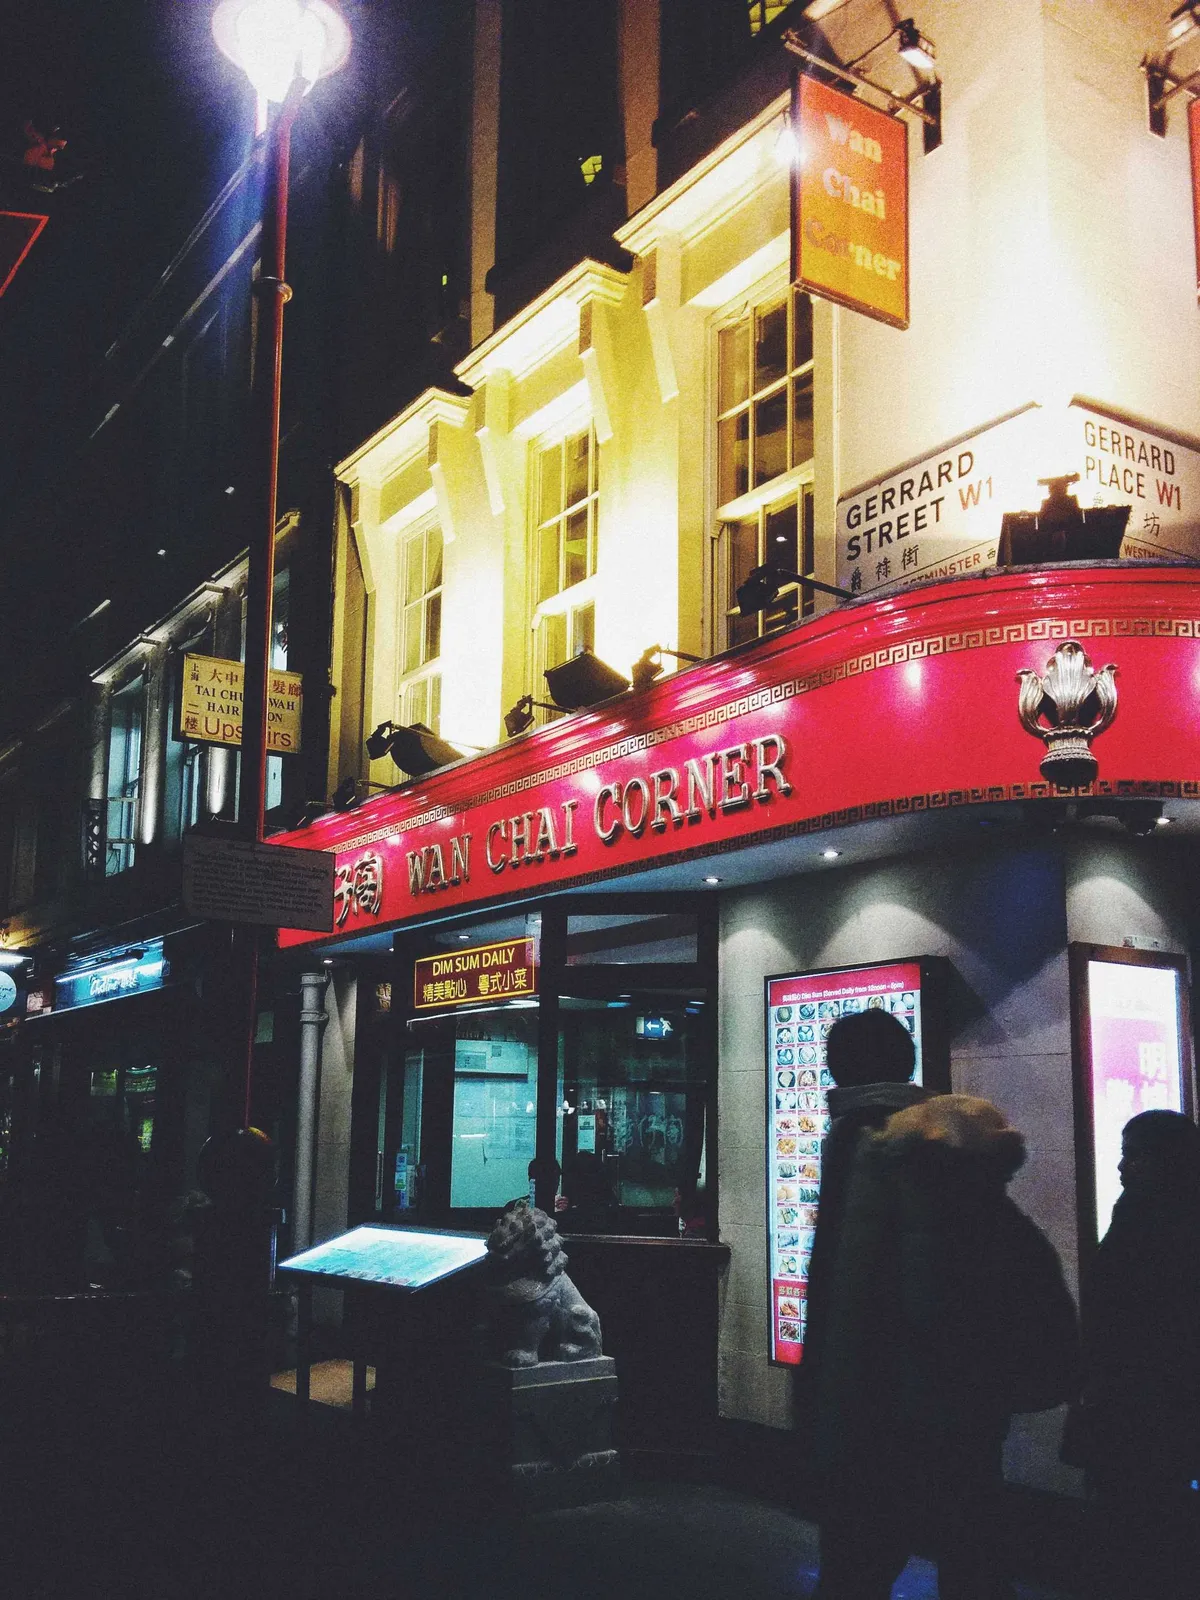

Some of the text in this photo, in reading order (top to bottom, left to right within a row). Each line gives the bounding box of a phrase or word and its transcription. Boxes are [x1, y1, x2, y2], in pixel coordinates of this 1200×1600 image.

[825, 112, 882, 163] Wan
[822, 167, 886, 220] Chai
[804, 218, 901, 281] Corner
[1084, 421, 1175, 476] GERRARD
[846, 451, 974, 530] GERRARD
[1085, 456, 1181, 511] PLACE W1
[846, 476, 993, 561] STREET W1
[195, 684, 216, 698] TAI
[207, 701, 240, 716] HAIR
[406, 832, 473, 896] WAN
[485, 799, 579, 874] CHAI
[594, 733, 793, 842] CORNER
[432, 947, 516, 976] DIM SUM DAILY
[422, 977, 468, 1003] 精美點心
